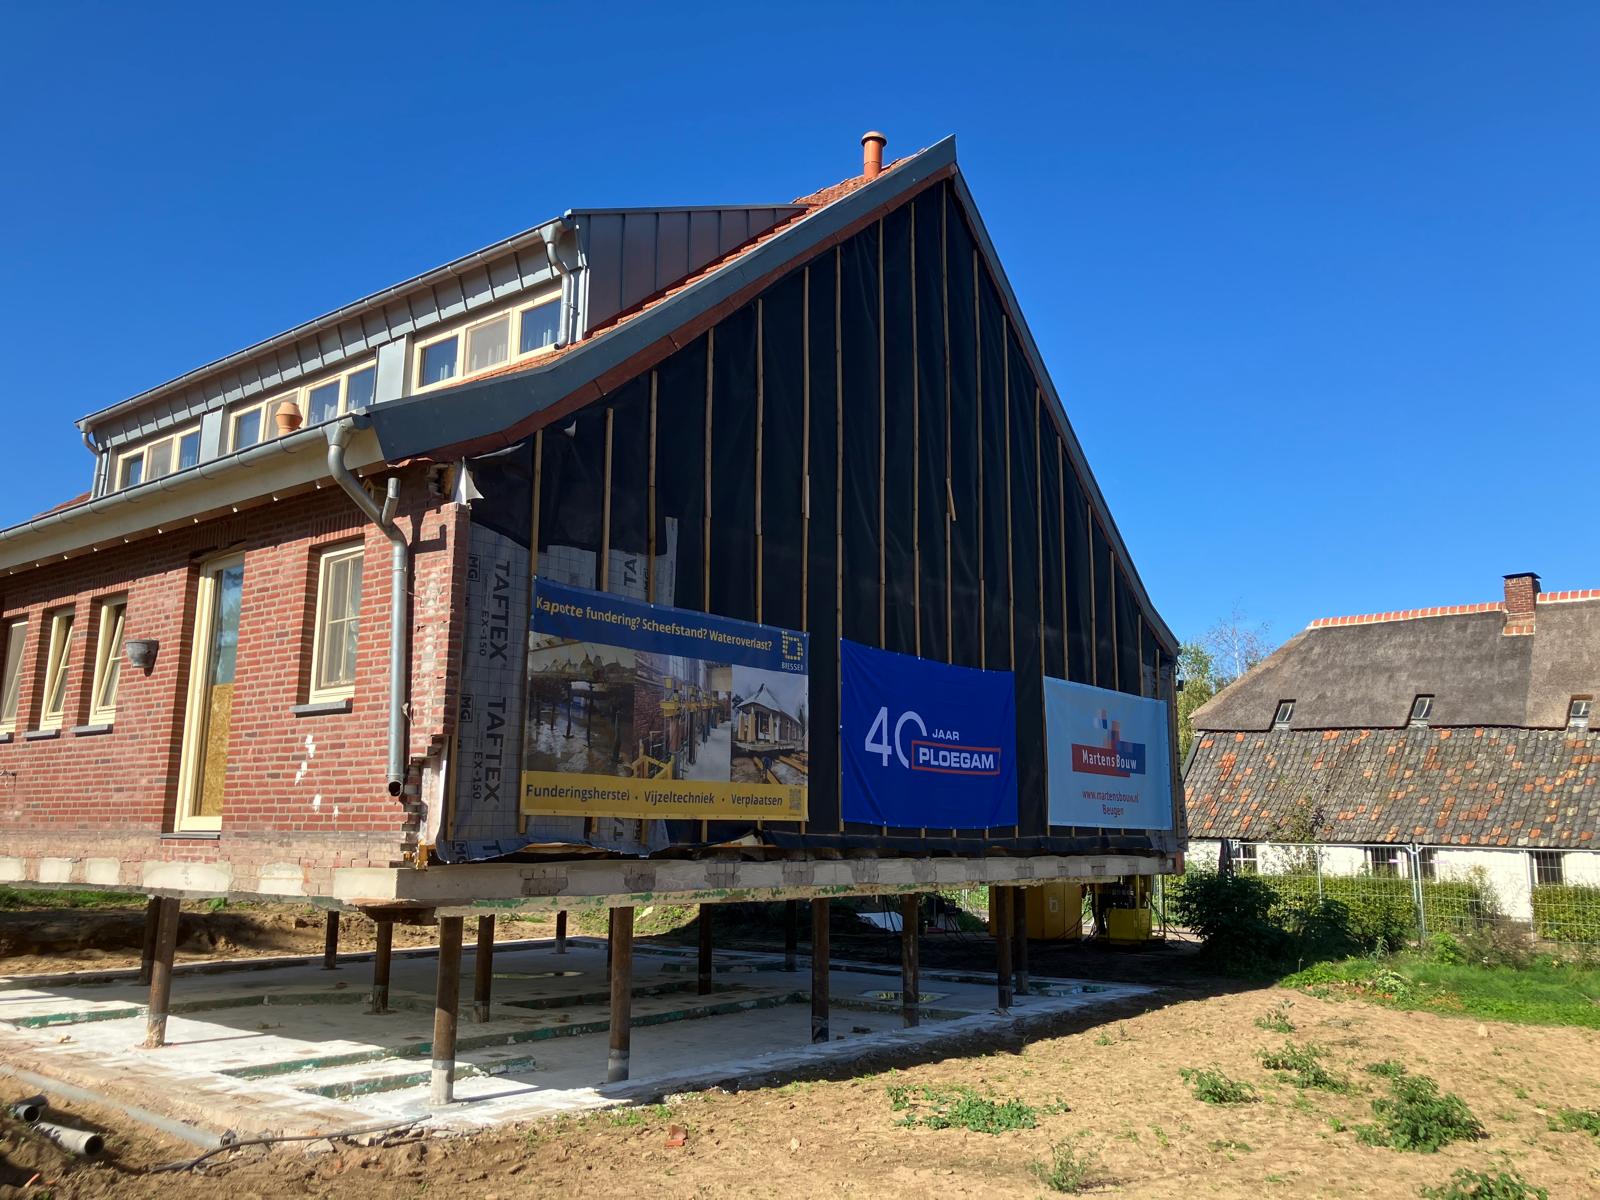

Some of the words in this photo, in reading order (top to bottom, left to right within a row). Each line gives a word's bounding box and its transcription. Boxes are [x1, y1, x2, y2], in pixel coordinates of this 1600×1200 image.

[479, 610, 490, 657] EX-150
[489, 561, 511, 661] TAFTEX
[536, 596, 583, 618] Kapotte
[586, 607, 640, 630] fundering?
[642, 619, 707, 639] Scheefstand?
[710, 630, 773, 651] Wateroverlast?
[484, 696, 506, 802] TAFTEX
[865, 706, 928, 768] 40
[919, 747, 995, 769] PLOEGAM
[932, 728, 960, 741] JAAR
[472, 751, 483, 800] EX-150
[526, 784, 630, 802] Funderingsherstel
[644, 791, 715, 806] Vijzeltechniek
[731, 794, 783, 807] Verplaatsen
